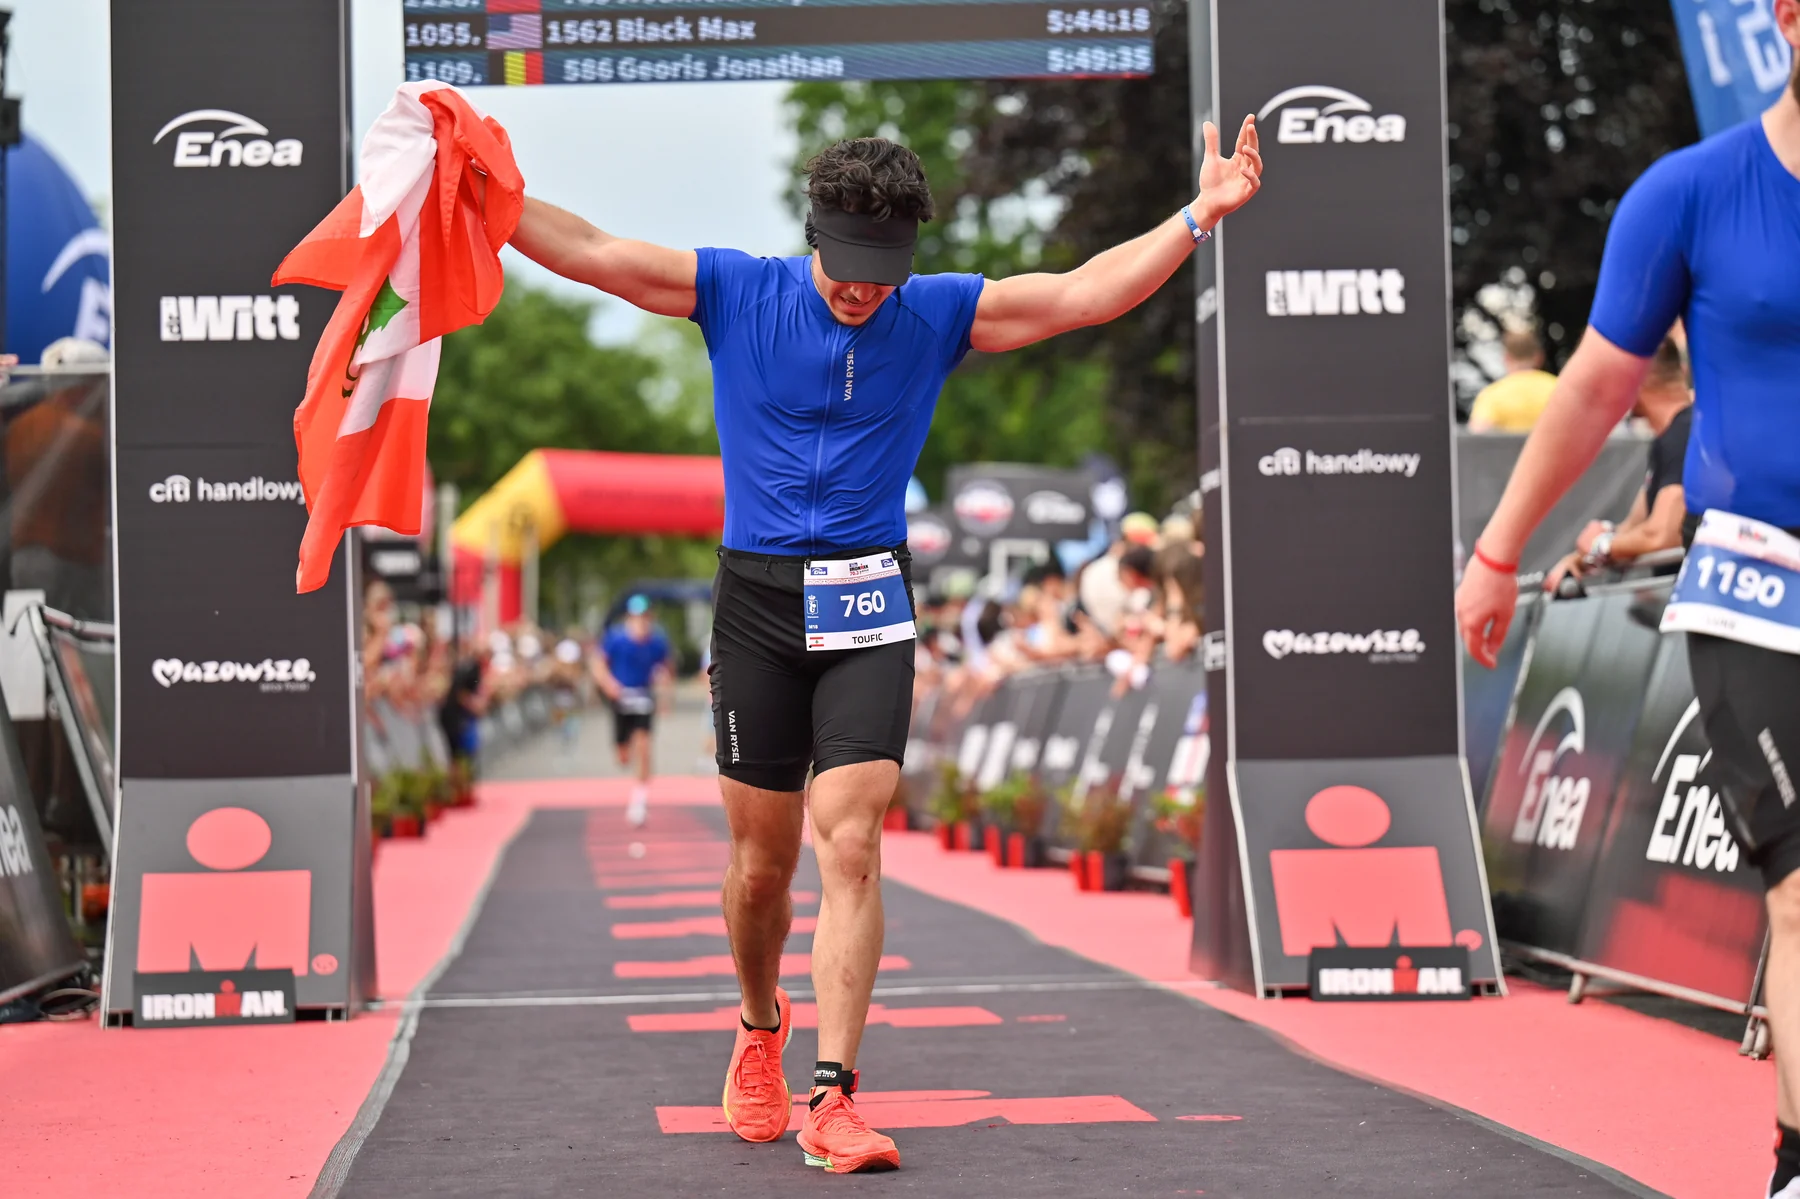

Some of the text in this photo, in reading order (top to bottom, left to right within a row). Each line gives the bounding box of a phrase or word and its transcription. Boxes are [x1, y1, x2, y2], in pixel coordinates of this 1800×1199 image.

[406, 8, 1151, 46] 1055. 1562 Black Max 5:44:18
[563, 57, 614, 82] 586
[617, 53, 707, 81] Georis
[712, 52, 844, 79] Jonathan
[1277, 108, 1406, 144] Enea
[174, 132, 303, 168] Enea
[1285, 268, 1406, 315] Witt
[178, 295, 300, 341] Witt
[844, 347, 854, 402] VAN RYSEL
[1258, 447, 1421, 478] citi handlowy
[149, 474, 191, 503] citi
[1697, 555, 1785, 608] 1190
[840, 590, 885, 618] 760
[852, 632, 883, 645] TOUFIC
[728, 710, 740, 764] VAN RYSEL
[1512, 750, 1591, 850] Enea
[1319, 956, 1463, 995] IRONMAN
[142, 980, 286, 1020] IRONMAN
